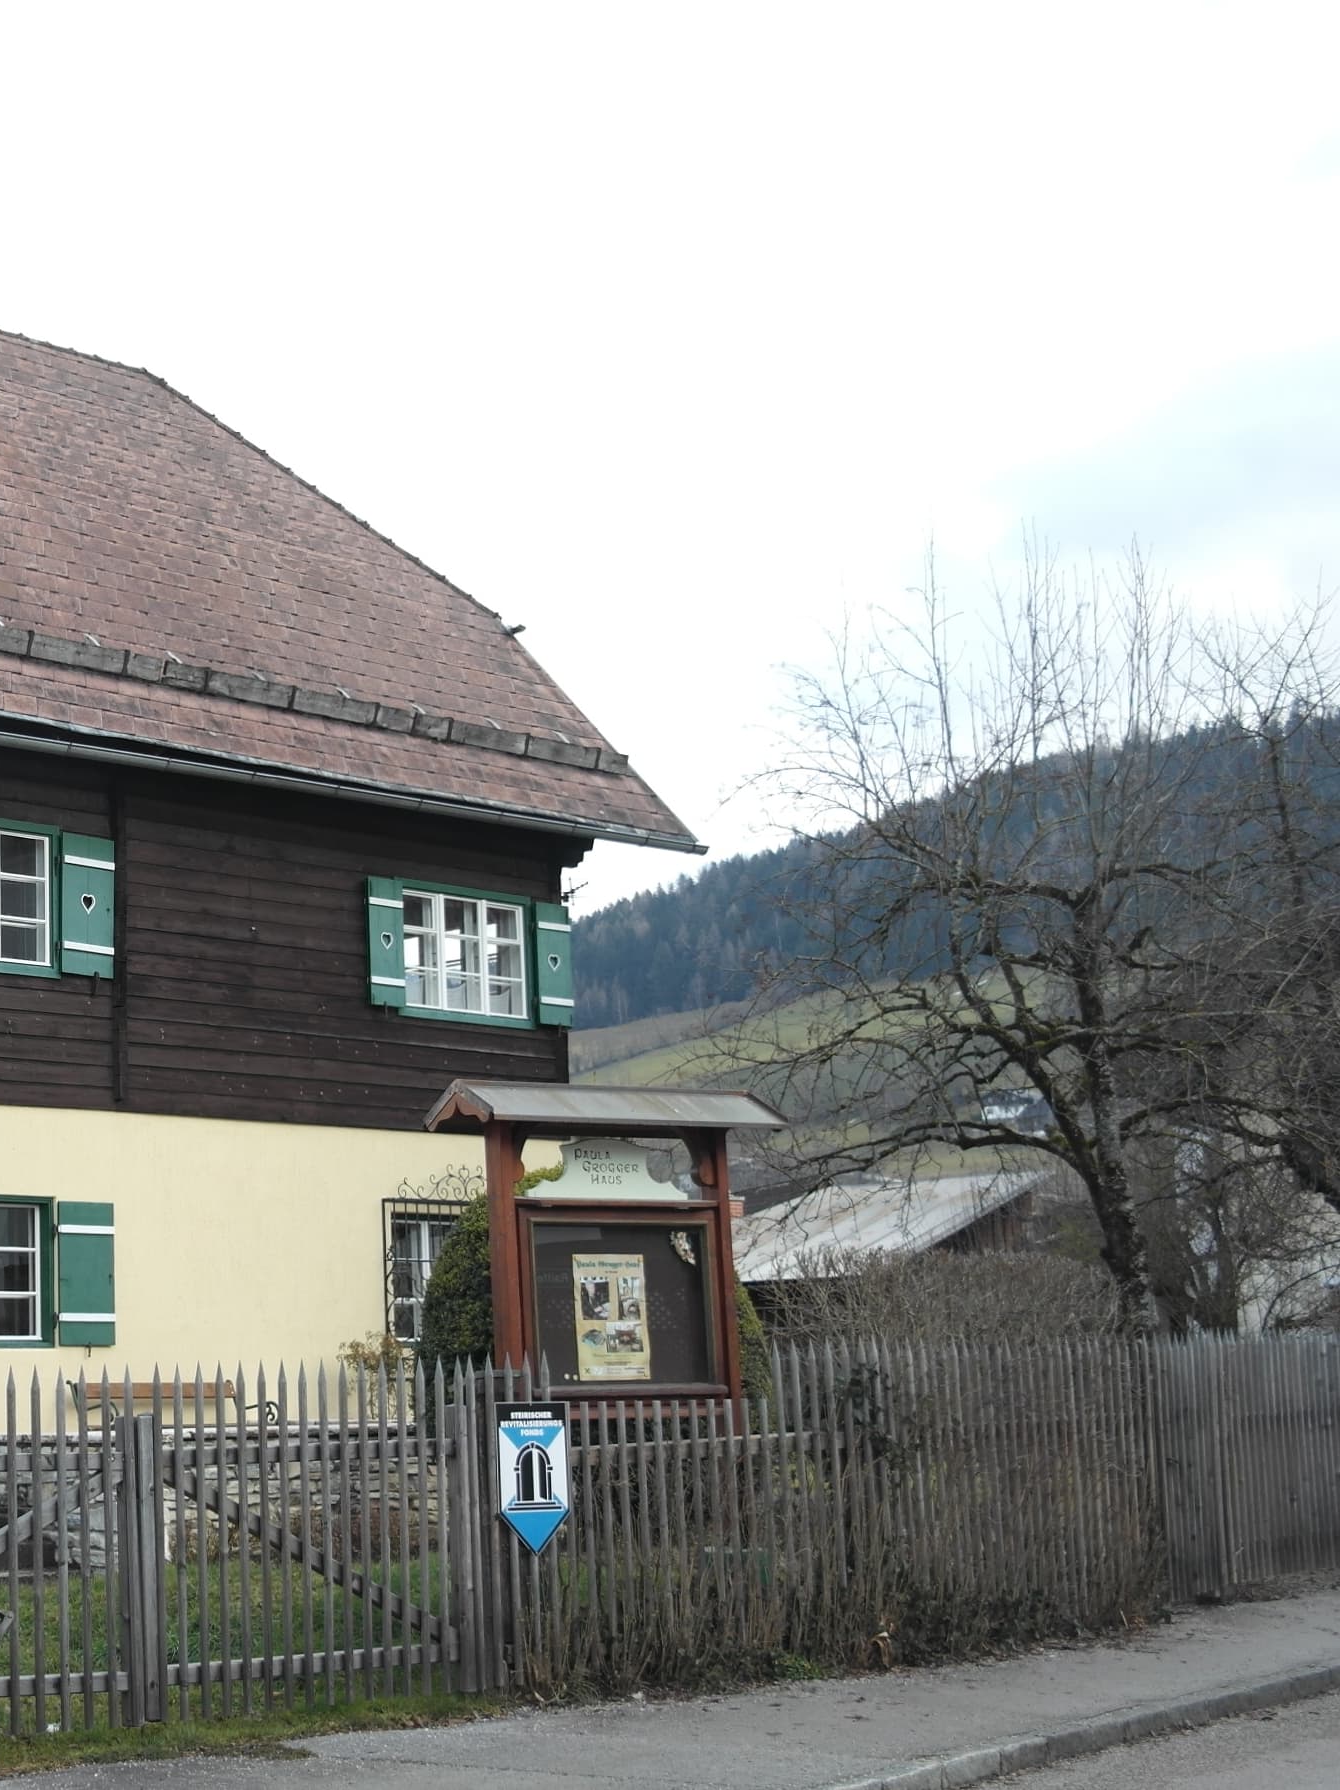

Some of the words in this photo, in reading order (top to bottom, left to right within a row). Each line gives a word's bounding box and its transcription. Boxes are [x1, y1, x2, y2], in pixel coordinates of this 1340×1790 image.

[574, 1148, 611, 1160] PAULA
[582, 1160, 639, 1172] GROGGER
[591, 1174, 622, 1184] HAUS
[510, 1411, 552, 1419] STEIRISCHER
[520, 1428, 544, 1436] FONDS
